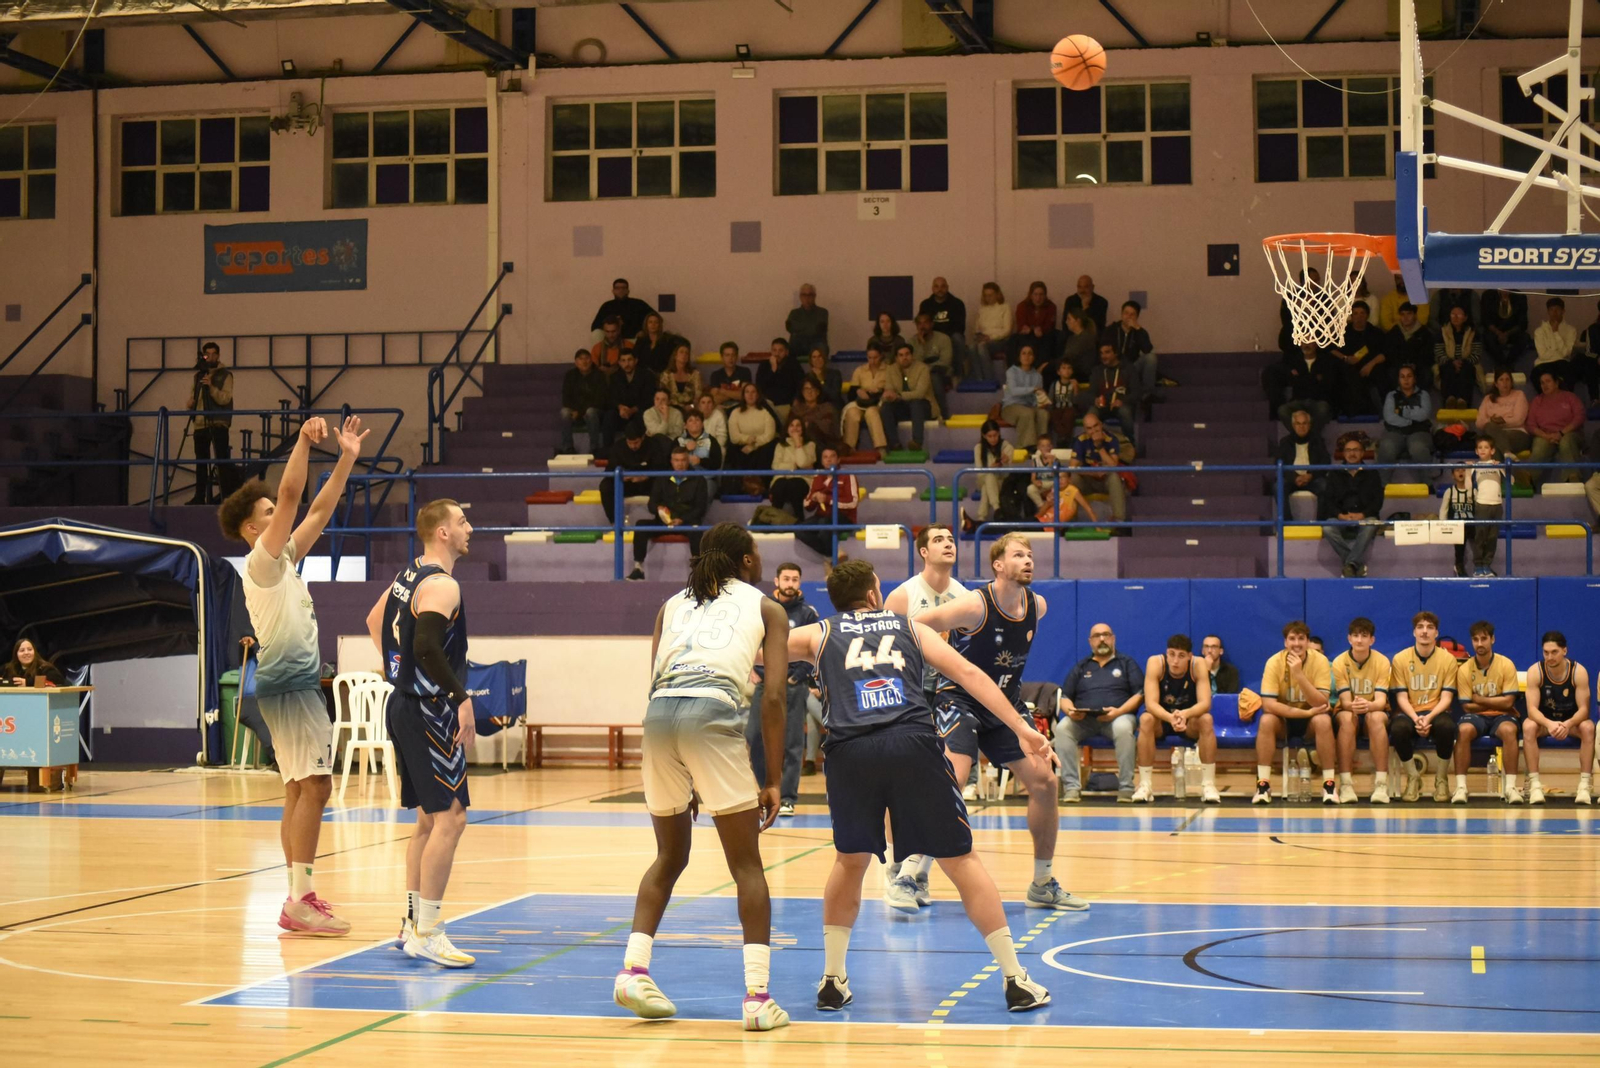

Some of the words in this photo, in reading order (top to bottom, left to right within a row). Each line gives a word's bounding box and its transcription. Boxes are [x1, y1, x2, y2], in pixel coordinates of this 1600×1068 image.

[873, 206, 880, 216] 3
[216, 245, 330, 273] deportes
[667, 601, 740, 650] 93
[844, 634, 906, 672] 44
[1410, 674, 1437, 691] ULB
[860, 689, 903, 709] UBAGO
